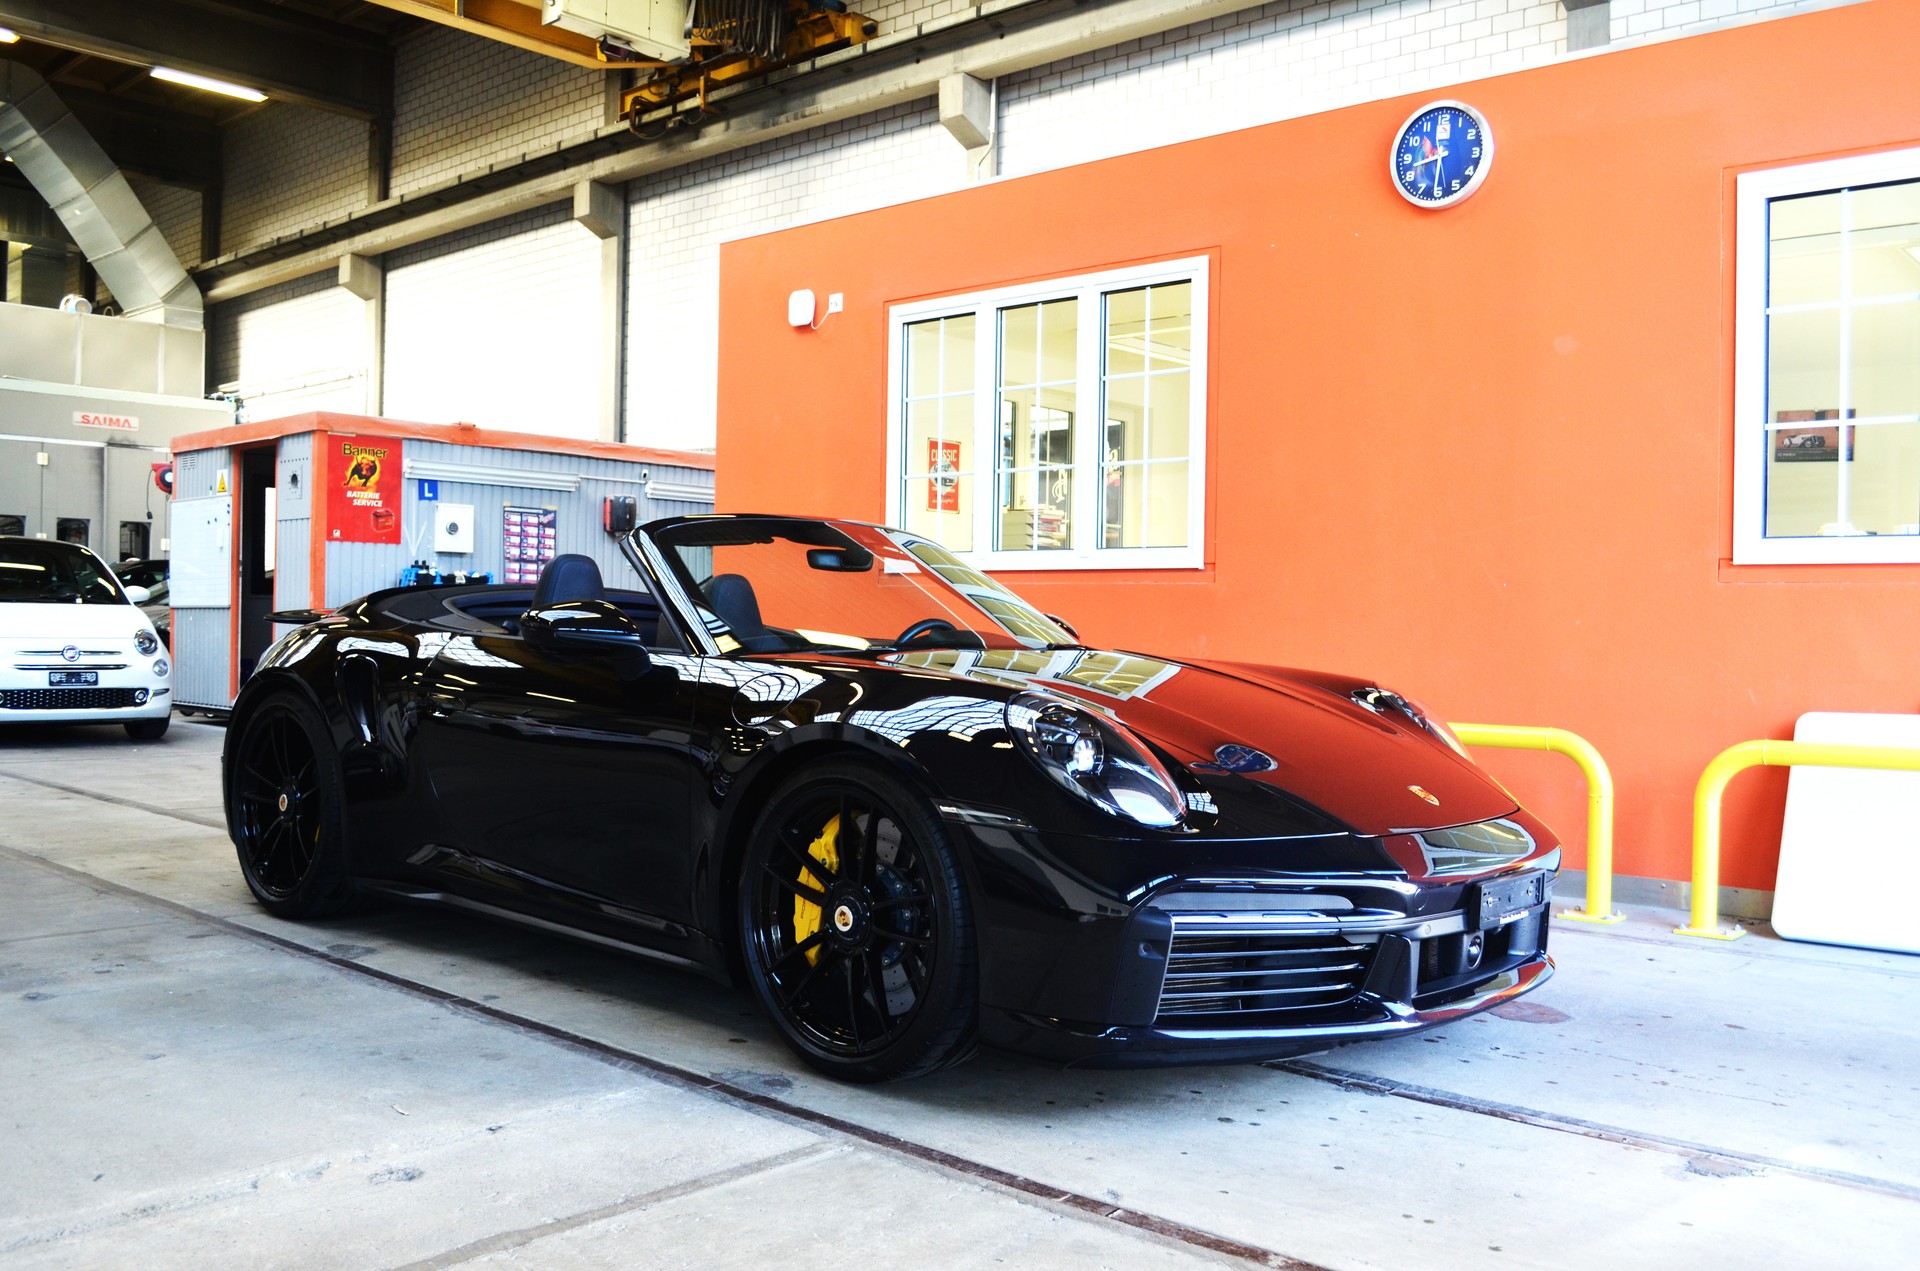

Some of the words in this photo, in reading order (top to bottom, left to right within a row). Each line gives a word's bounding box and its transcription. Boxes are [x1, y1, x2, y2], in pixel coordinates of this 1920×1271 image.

[1438, 114, 1450, 125] 12
[1458, 117, 1462, 128] 1
[1424, 122, 1431, 132] 11
[1467, 129, 1476, 140] 2
[1409, 136, 1420, 146] 10
[1472, 147, 1480, 158] 3
[1404, 154, 1412, 164] 9
[1406, 171, 1415, 181] 8
[1465, 166, 1474, 176] 4
[1418, 184, 1426, 194] 7
[1452, 180, 1460, 190] 5
[1434, 187, 1442, 198] 6
[81, 414, 132, 428] SAIMA
[343, 443, 388, 458] Banner
[931, 449, 957, 462] CLSSIC
[346, 490, 380, 499] BATTERIE
[424, 483, 433, 497] L
